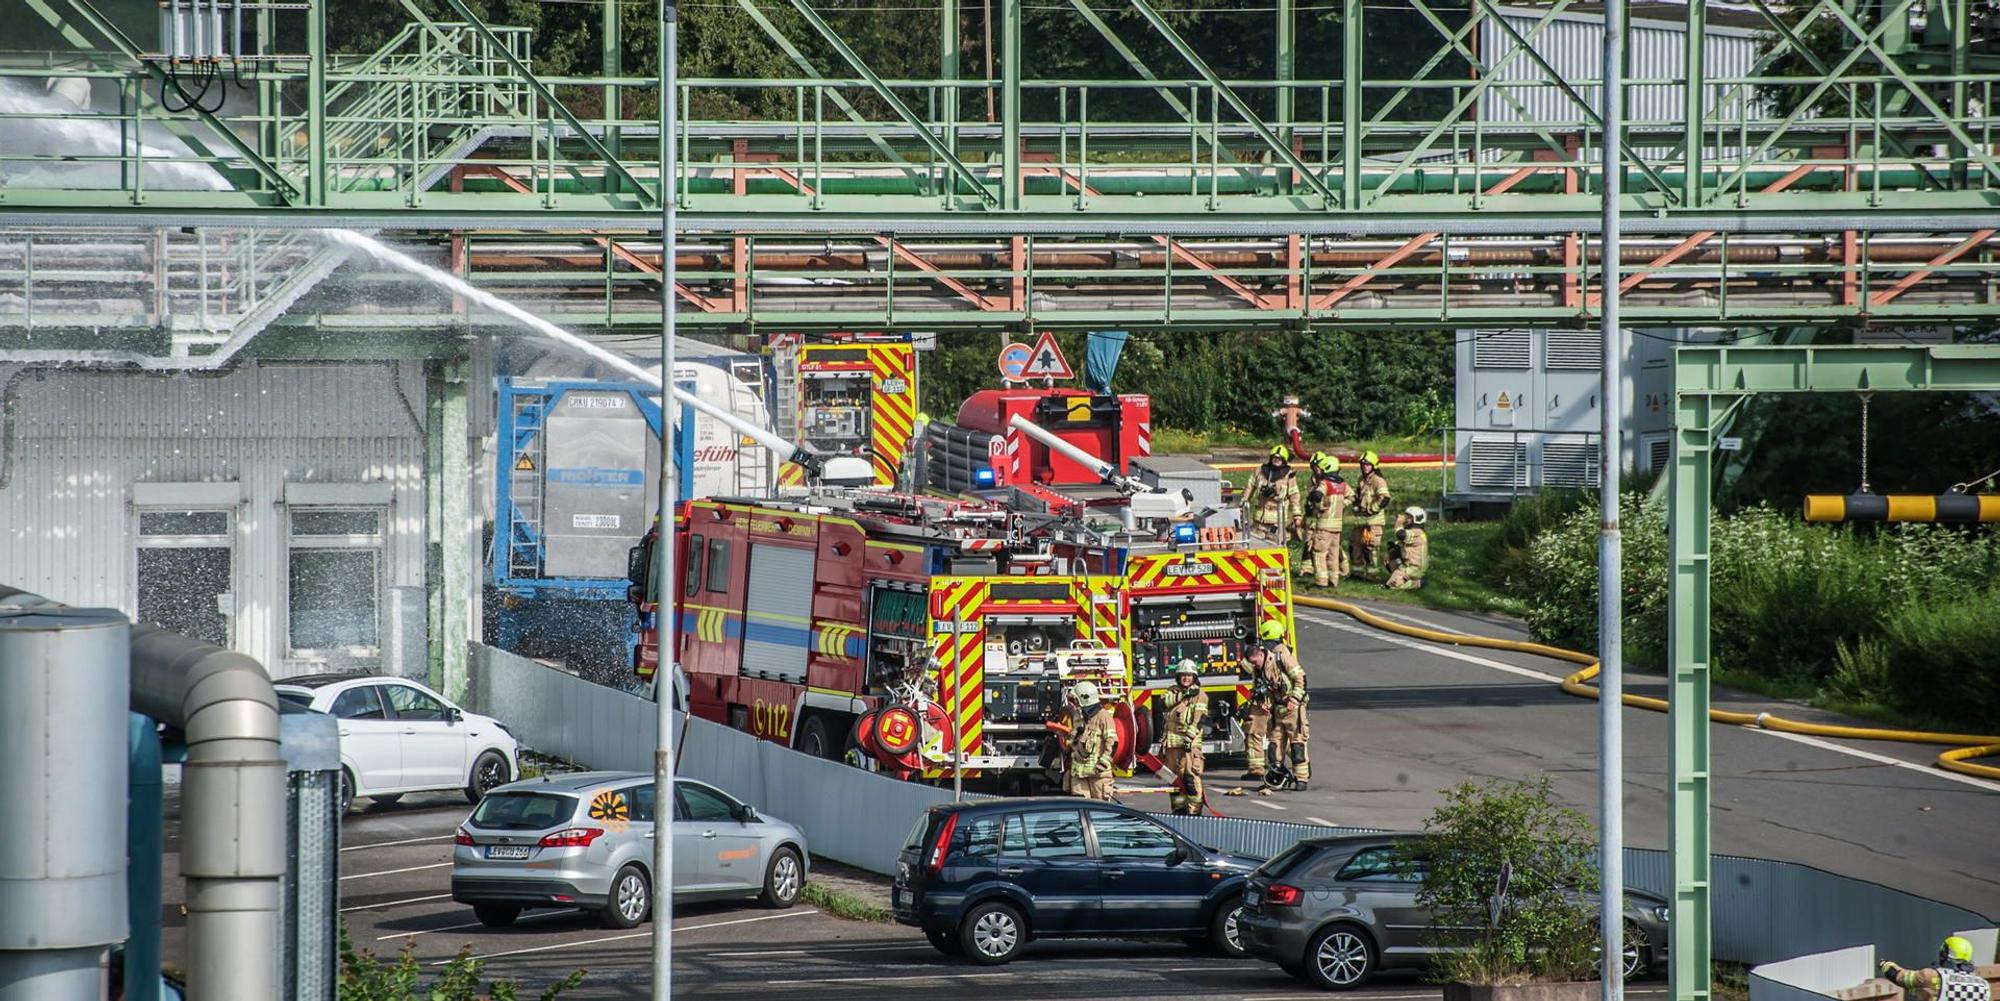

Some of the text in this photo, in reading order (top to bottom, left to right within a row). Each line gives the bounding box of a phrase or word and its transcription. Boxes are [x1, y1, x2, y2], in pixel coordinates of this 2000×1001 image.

[694, 445, 736, 462] eführ
[1167, 566, 1185, 575] LEV
[1197, 564, 1213, 573] 528
[767, 702, 788, 737] 112
